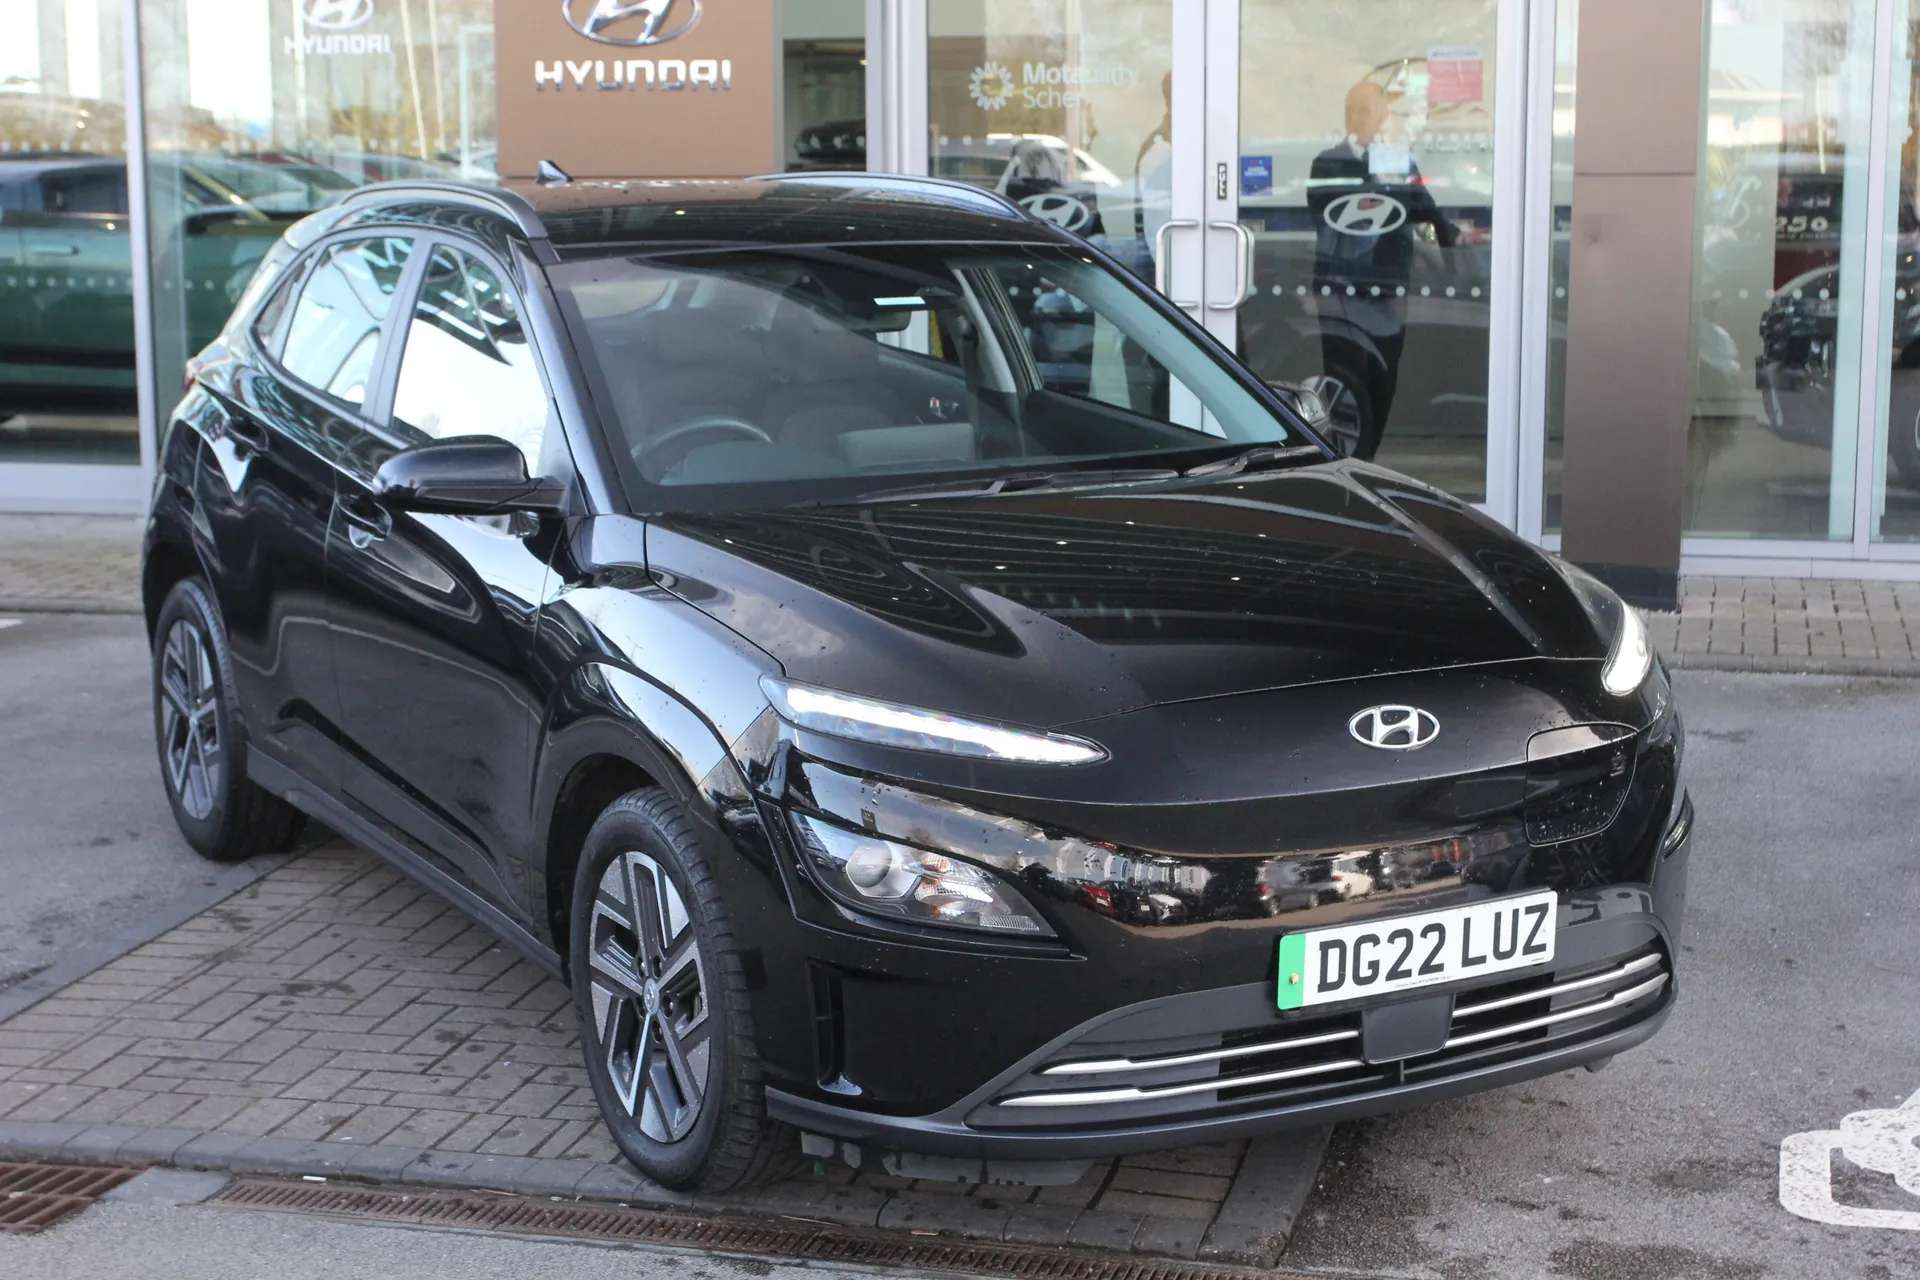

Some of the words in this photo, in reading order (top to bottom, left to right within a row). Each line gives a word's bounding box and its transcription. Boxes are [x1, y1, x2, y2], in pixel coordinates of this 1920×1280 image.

[283, 33, 391, 55] HYUNDAI
[535, 59, 732, 90] HYUNDAI
[1218, 163, 1227, 198] PULL
[1317, 922, 1447, 993] DG22
[1461, 902, 1550, 968] LUZ
